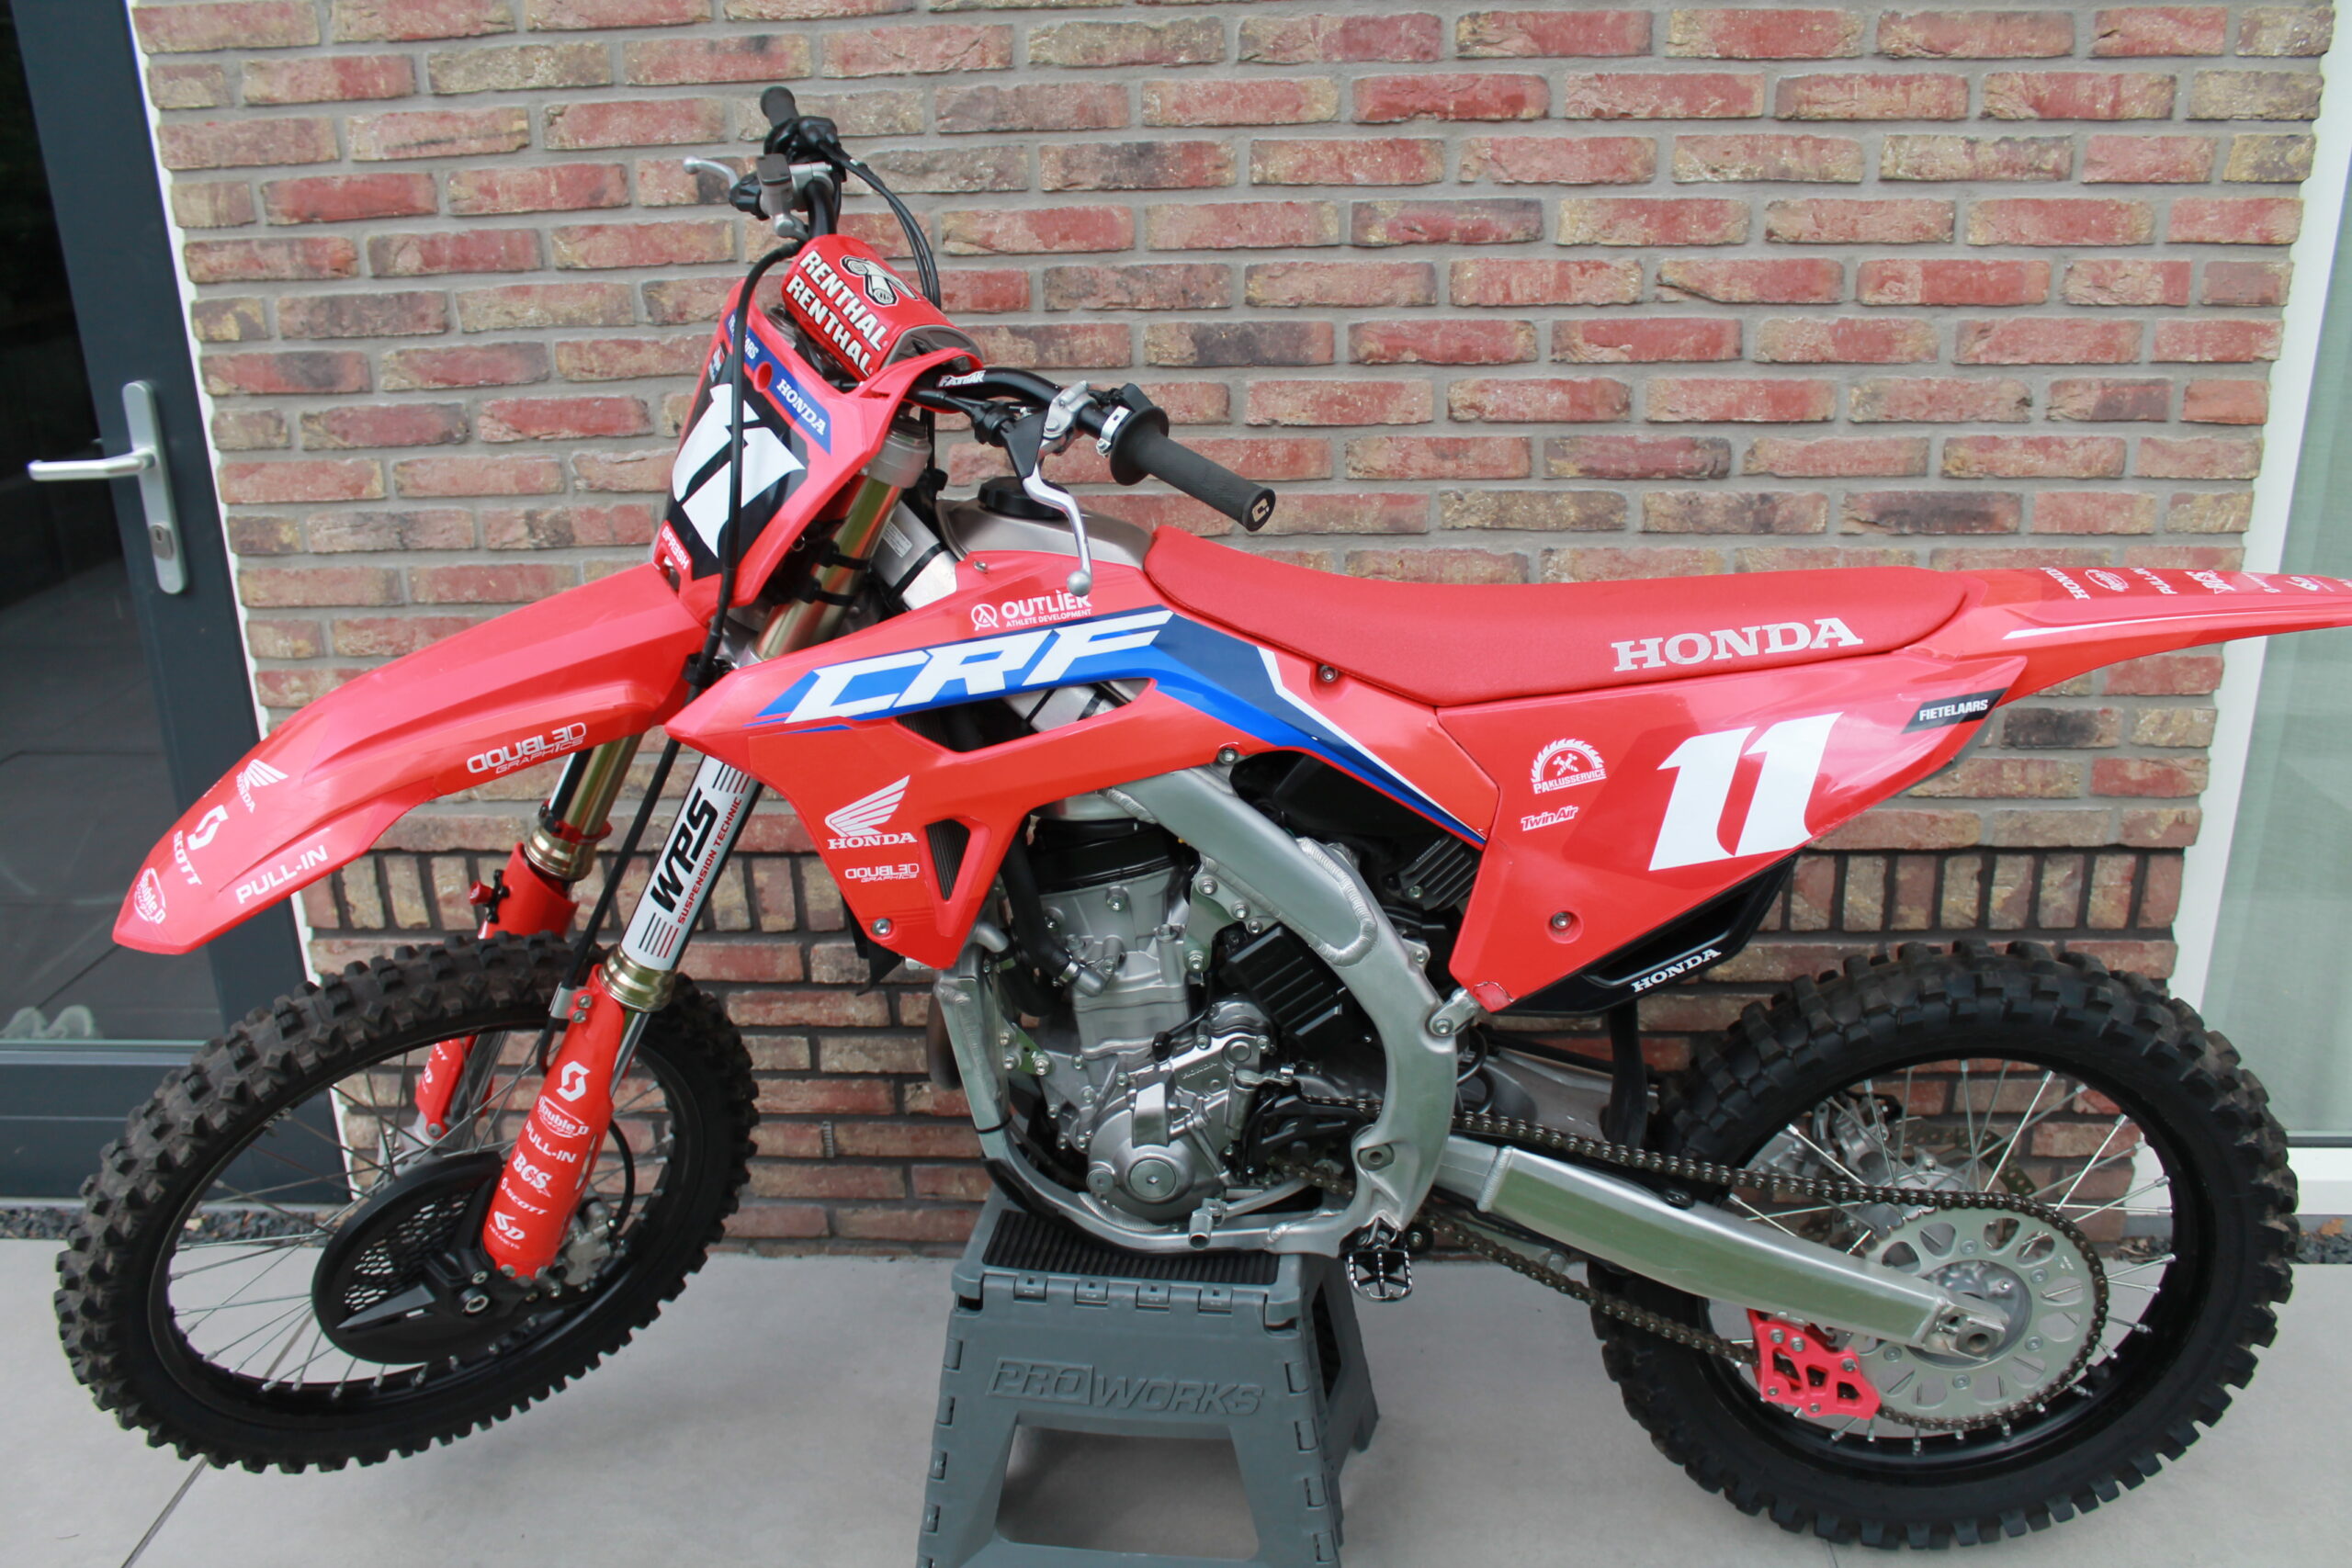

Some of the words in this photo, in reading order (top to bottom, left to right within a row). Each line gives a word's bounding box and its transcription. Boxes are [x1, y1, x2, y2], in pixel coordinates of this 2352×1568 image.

[786, 275, 871, 378] RENTHAL
[799, 250, 887, 352] RENTHAL
[776, 378, 827, 435] HONDA
[1001, 589, 1092, 619] OUTLIER
[1006, 616, 1037, 628] ATHLETE
[1038, 608, 1092, 624] DEVELOPMENT
[784, 609, 1174, 724] CRF
[1611, 616, 1864, 671] HONDA
[1918, 699, 1989, 721] FIETELAARS
[495, 738, 584, 774] GRAPHICS
[236, 772, 256, 814] HONDA
[1521, 814, 1555, 831] Twin
[1555, 806, 1579, 822] Air
[1648, 712, 1844, 871] 11
[174, 830, 203, 886] SCOTT
[650, 787, 719, 914] WPS
[678, 850, 718, 925] SUSPENSION
[715, 796, 742, 847] TECHNIC
[827, 831, 918, 850] HONDA
[234, 844, 330, 905] PULL-IN
[1631, 948, 1722, 993] HONDA
[526, 1119, 577, 1163] PULL-IN
